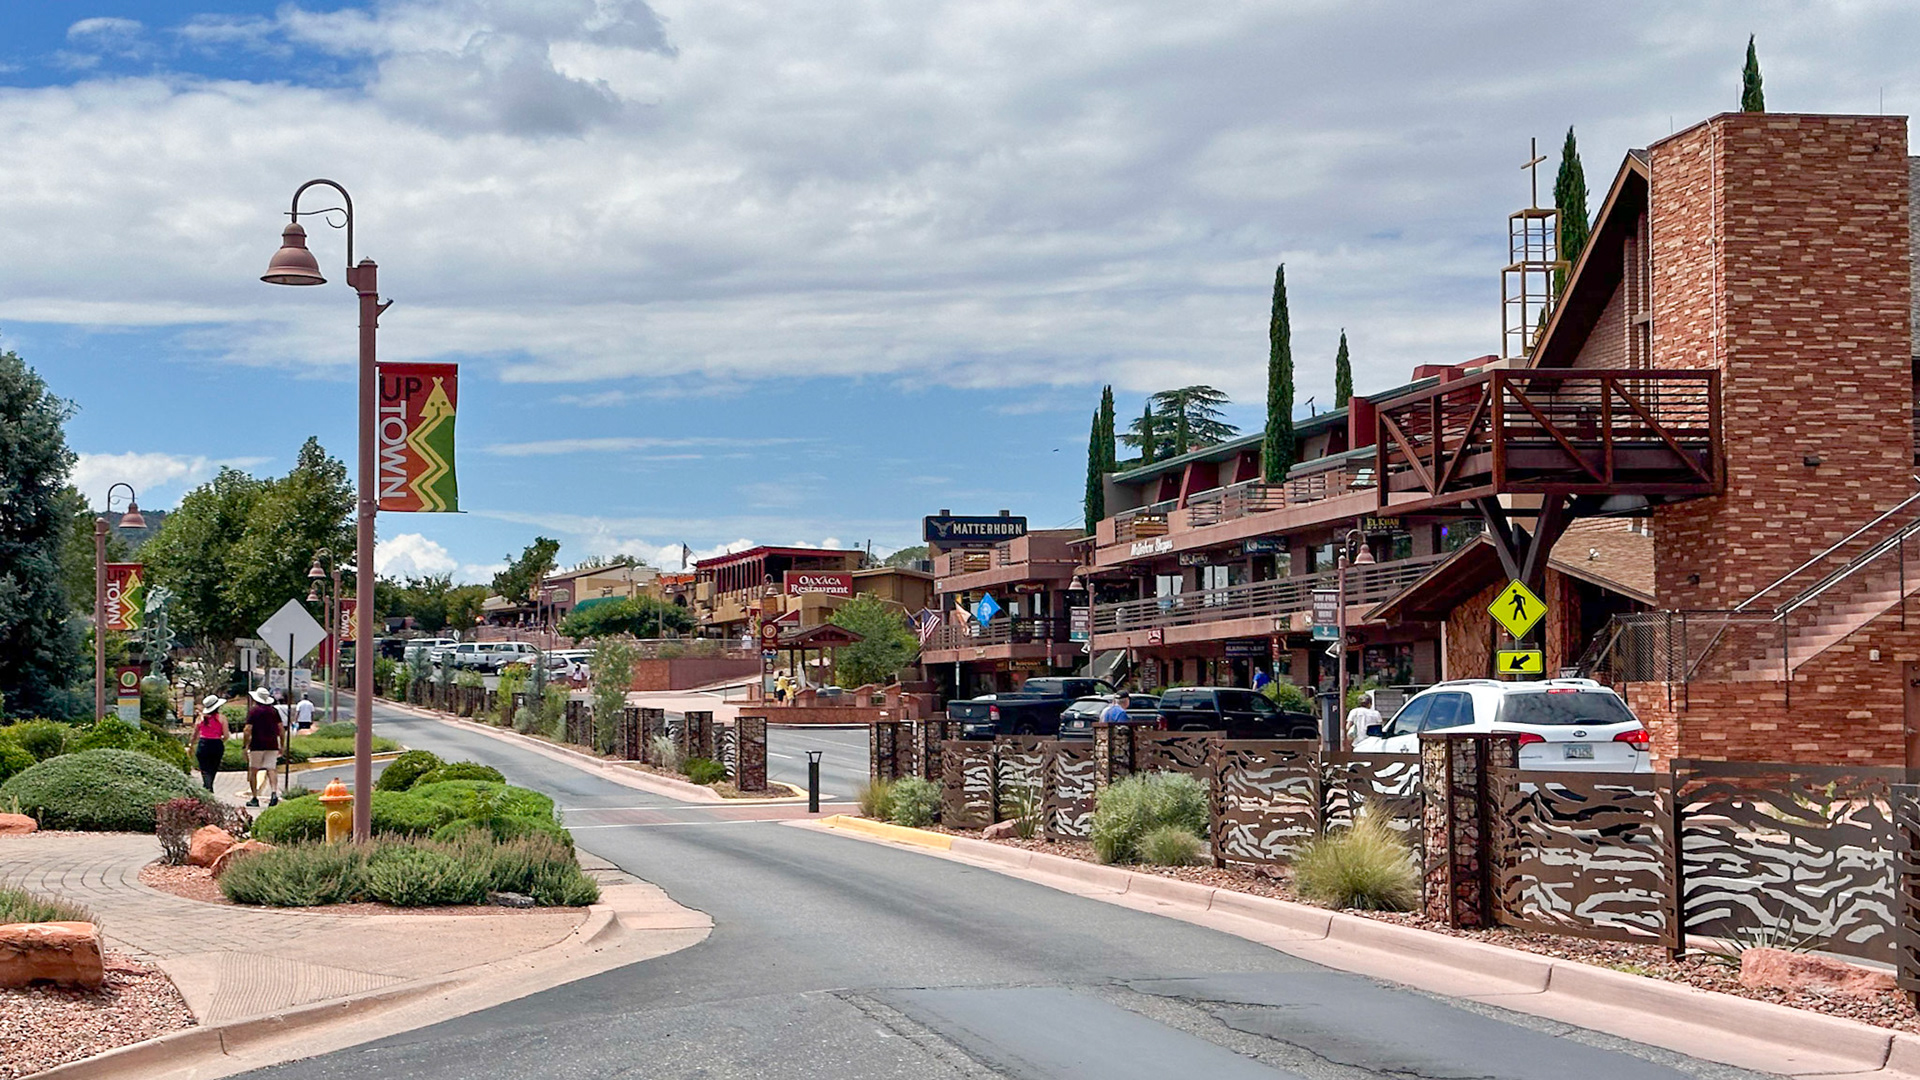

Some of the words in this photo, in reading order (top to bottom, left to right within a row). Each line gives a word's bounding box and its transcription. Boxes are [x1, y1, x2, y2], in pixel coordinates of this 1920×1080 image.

[381, 377, 422, 401] UP
[380, 400, 408, 498] TOWN
[953, 523, 1023, 535] MATTERHORN
[107, 569, 126, 582] UP
[790, 584, 848, 595] Restaurant
[106, 580, 121, 625] TOWN
[340, 609, 350, 637] TOWN
[766, 627, 773, 636] P
